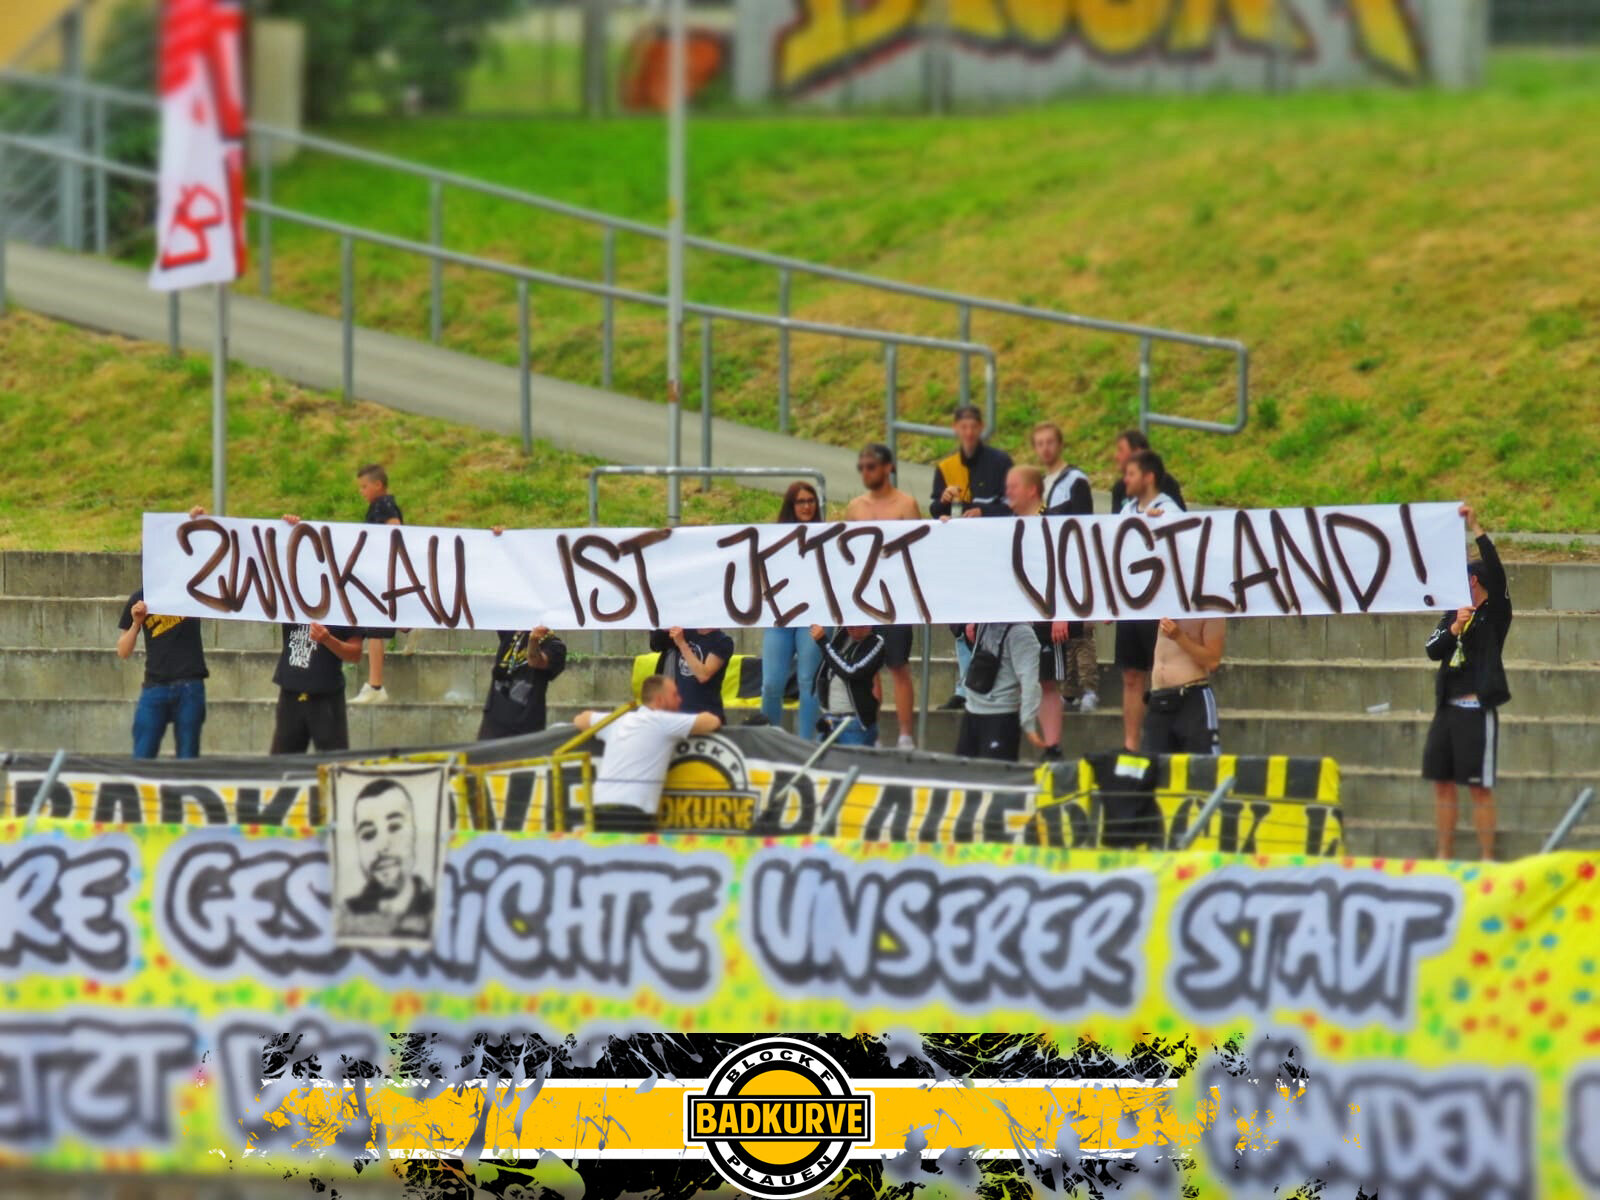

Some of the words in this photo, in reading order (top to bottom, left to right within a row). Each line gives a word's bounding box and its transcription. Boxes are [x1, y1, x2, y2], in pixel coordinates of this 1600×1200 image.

[176, 518, 474, 629] ZWICKAU
[557, 527, 672, 628] IST
[716, 522, 931, 627] JETZT
[1011, 502, 1435, 620] VOIGTLAND!
[656, 795, 756, 830] DKURVE
[752, 857, 1145, 1011] UNSERER
[1173, 876, 1457, 1017] STADT
